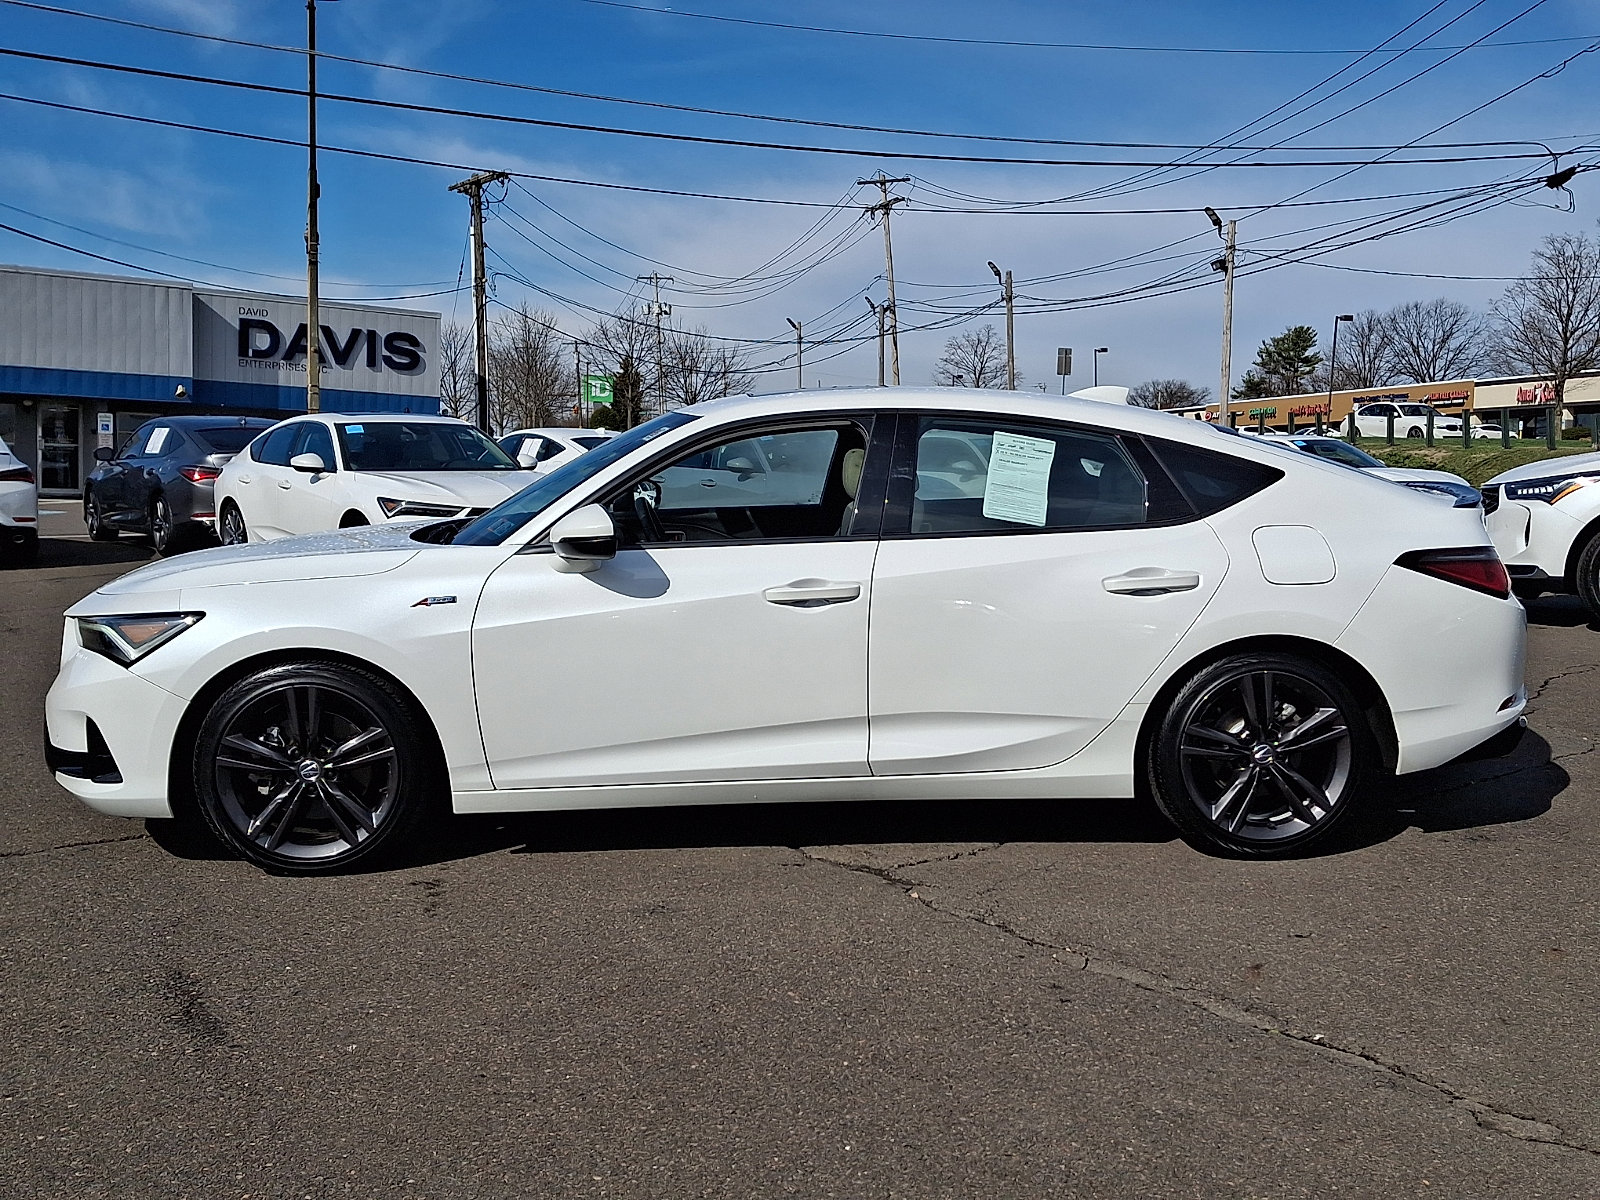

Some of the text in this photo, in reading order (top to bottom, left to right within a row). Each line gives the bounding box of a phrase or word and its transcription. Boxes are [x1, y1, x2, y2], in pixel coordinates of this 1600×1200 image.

[238, 306, 269, 317] DAVID
[238, 317, 421, 371] DAVIS
[588, 379, 611, 397] TD
